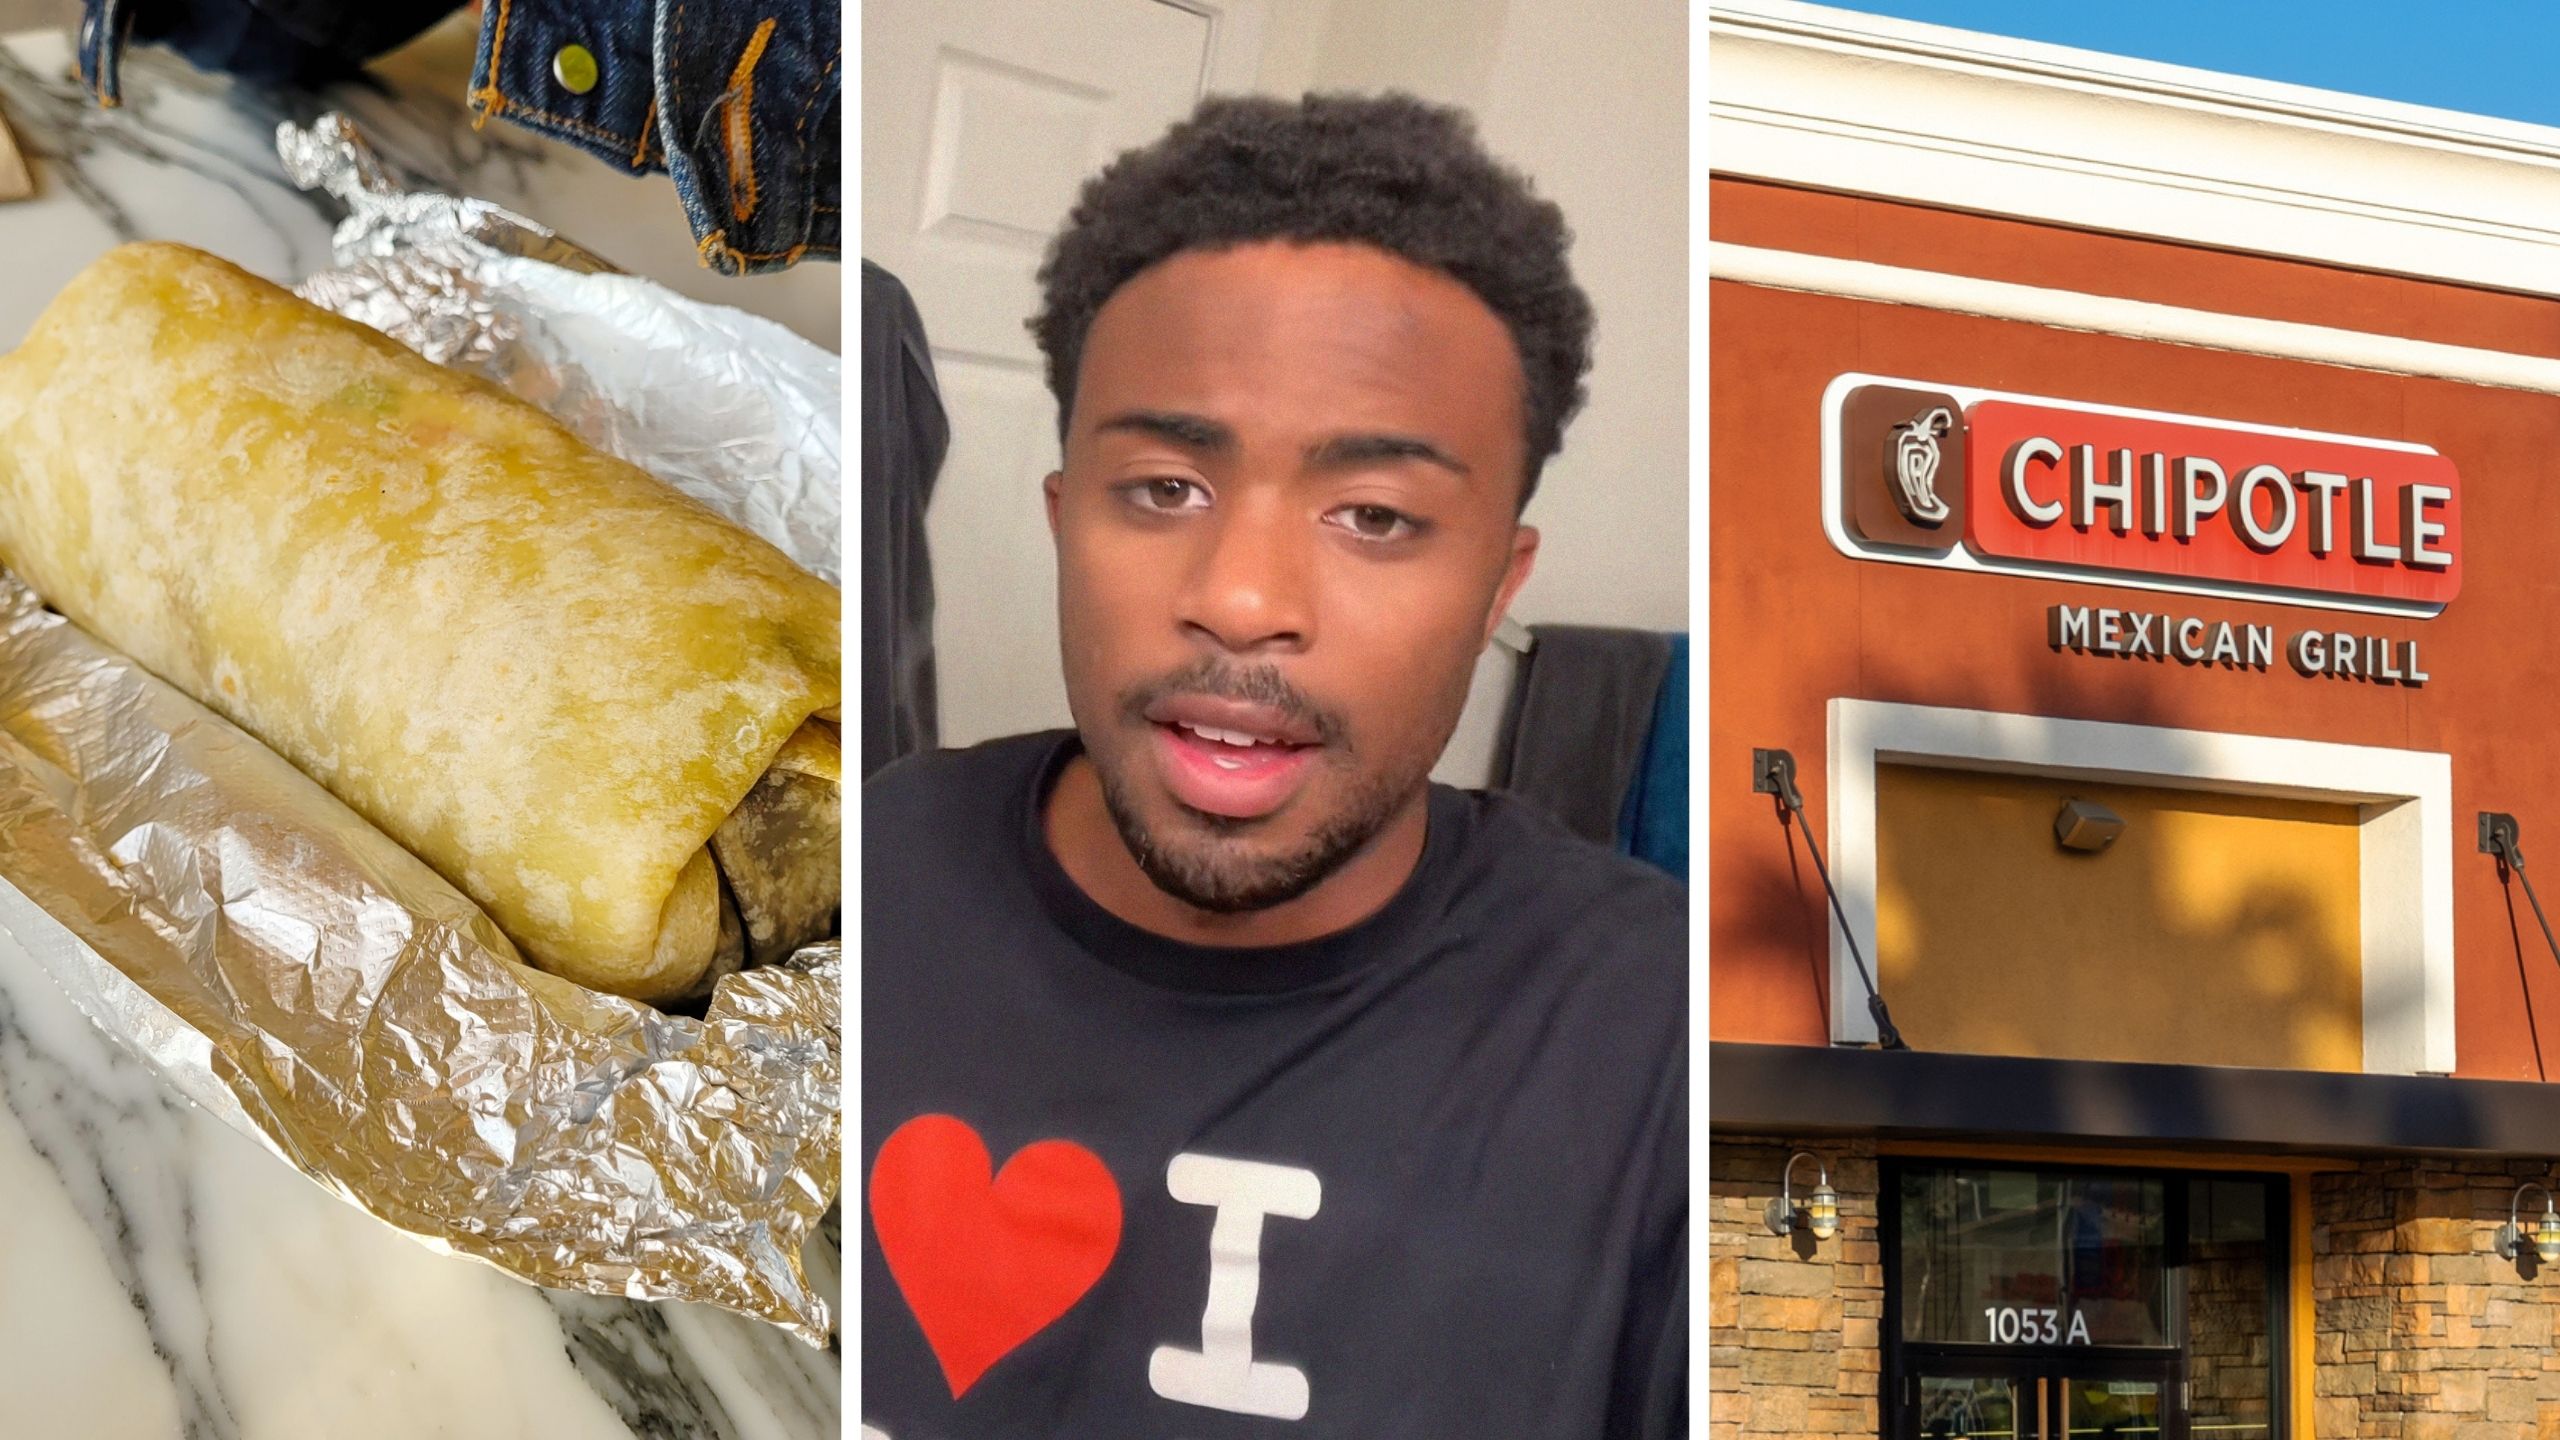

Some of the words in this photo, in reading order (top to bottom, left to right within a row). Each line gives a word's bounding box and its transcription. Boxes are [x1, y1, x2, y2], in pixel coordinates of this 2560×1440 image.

[2009, 436, 2454, 567] CHIPOTLE
[2058, 604, 2273, 666] MEXICAN
[2299, 630, 2430, 682] GRILL
[1985, 1307, 2058, 1344] 1053
[2066, 1309, 2092, 1345] A
